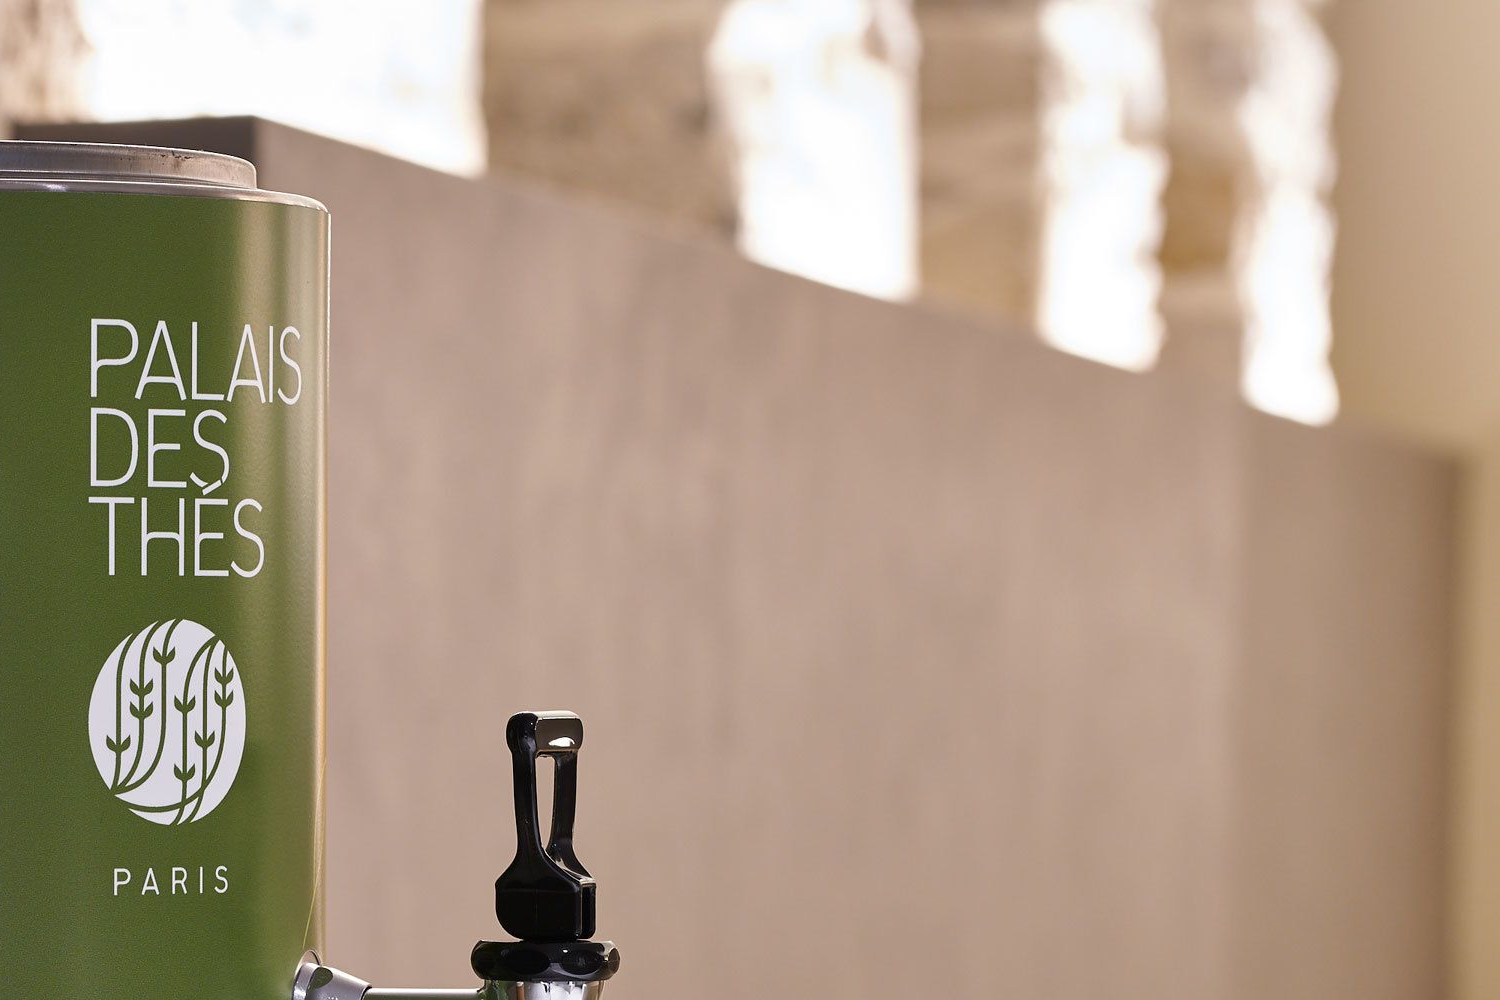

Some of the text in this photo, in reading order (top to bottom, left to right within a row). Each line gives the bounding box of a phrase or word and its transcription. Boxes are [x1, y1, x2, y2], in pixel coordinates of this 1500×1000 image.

[90, 318, 302, 405] PALAIS
[90, 407, 230, 488] DES
[88, 479, 265, 578] THÉS
[113, 865, 229, 896] PARIS
